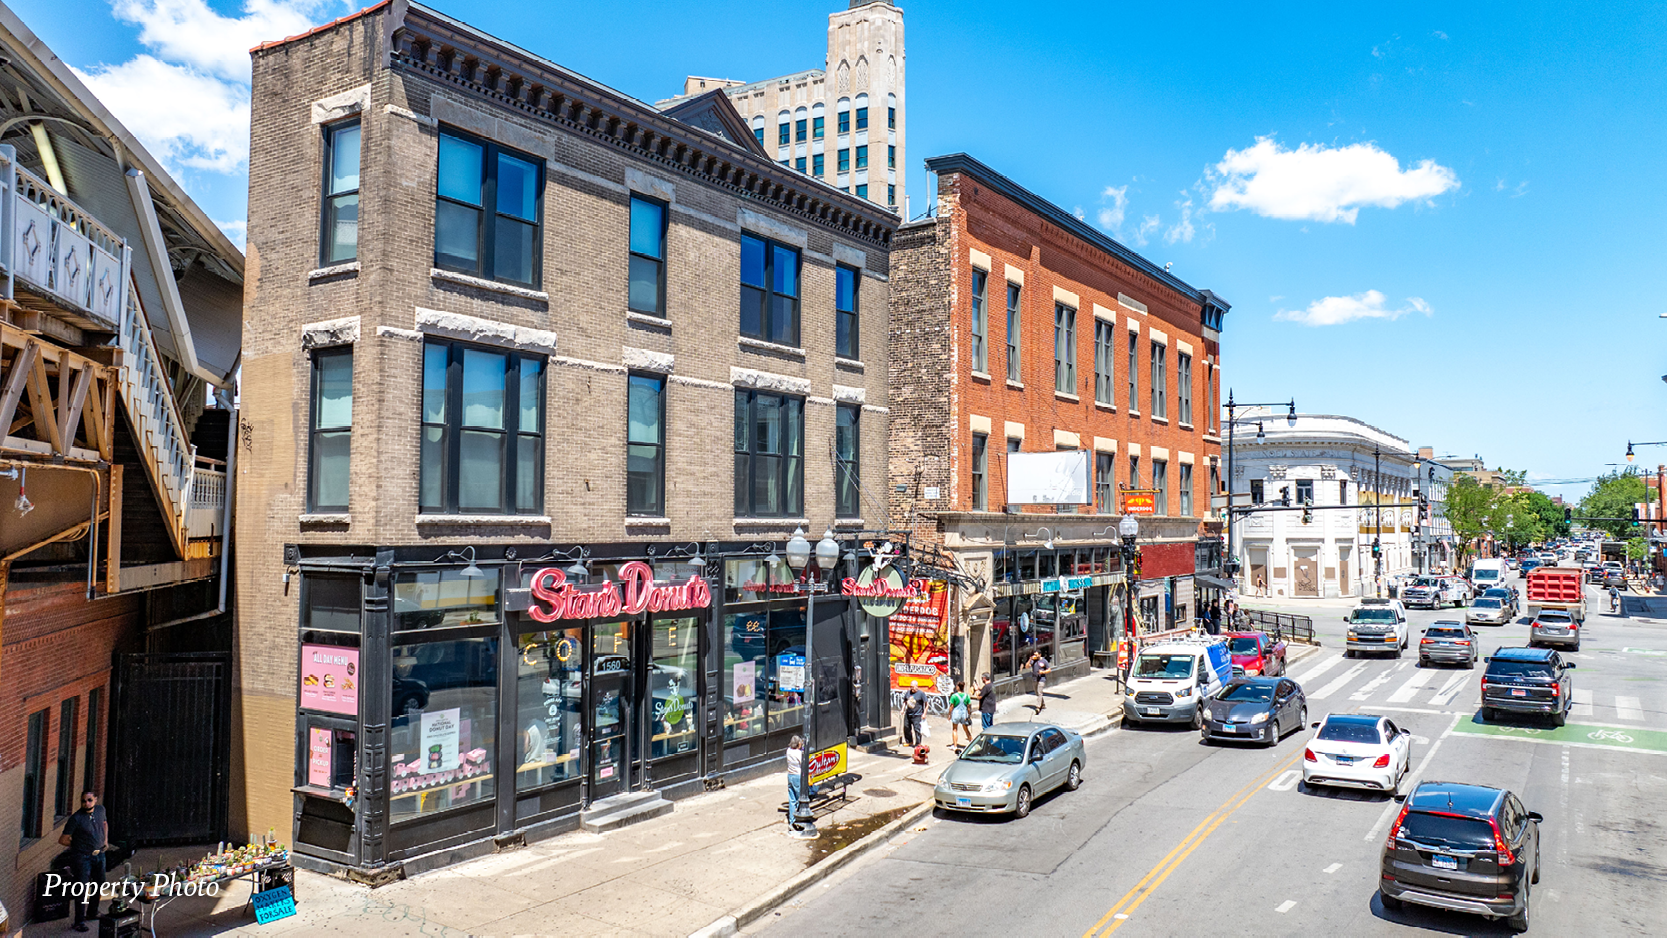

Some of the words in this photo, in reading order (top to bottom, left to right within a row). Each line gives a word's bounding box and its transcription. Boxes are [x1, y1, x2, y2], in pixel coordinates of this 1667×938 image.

[528, 567, 622, 623] Stan's
[618, 561, 711, 615] Donuts
[841, 577, 877, 597] Stan's
[873, 577, 918, 598] Donuts
[313, 653, 322, 664] ALL
[323, 654, 333, 665] DAY
[333, 655, 348, 666] MENU
[602, 660, 621, 671] 1560
[672, 697, 694, 711] Donuts
[429, 725, 445, 733] DONUT
[313, 745, 329, 754] ORDER
[312, 758, 329, 767] PICKUP
[255, 889, 288, 904] OXYGEN
